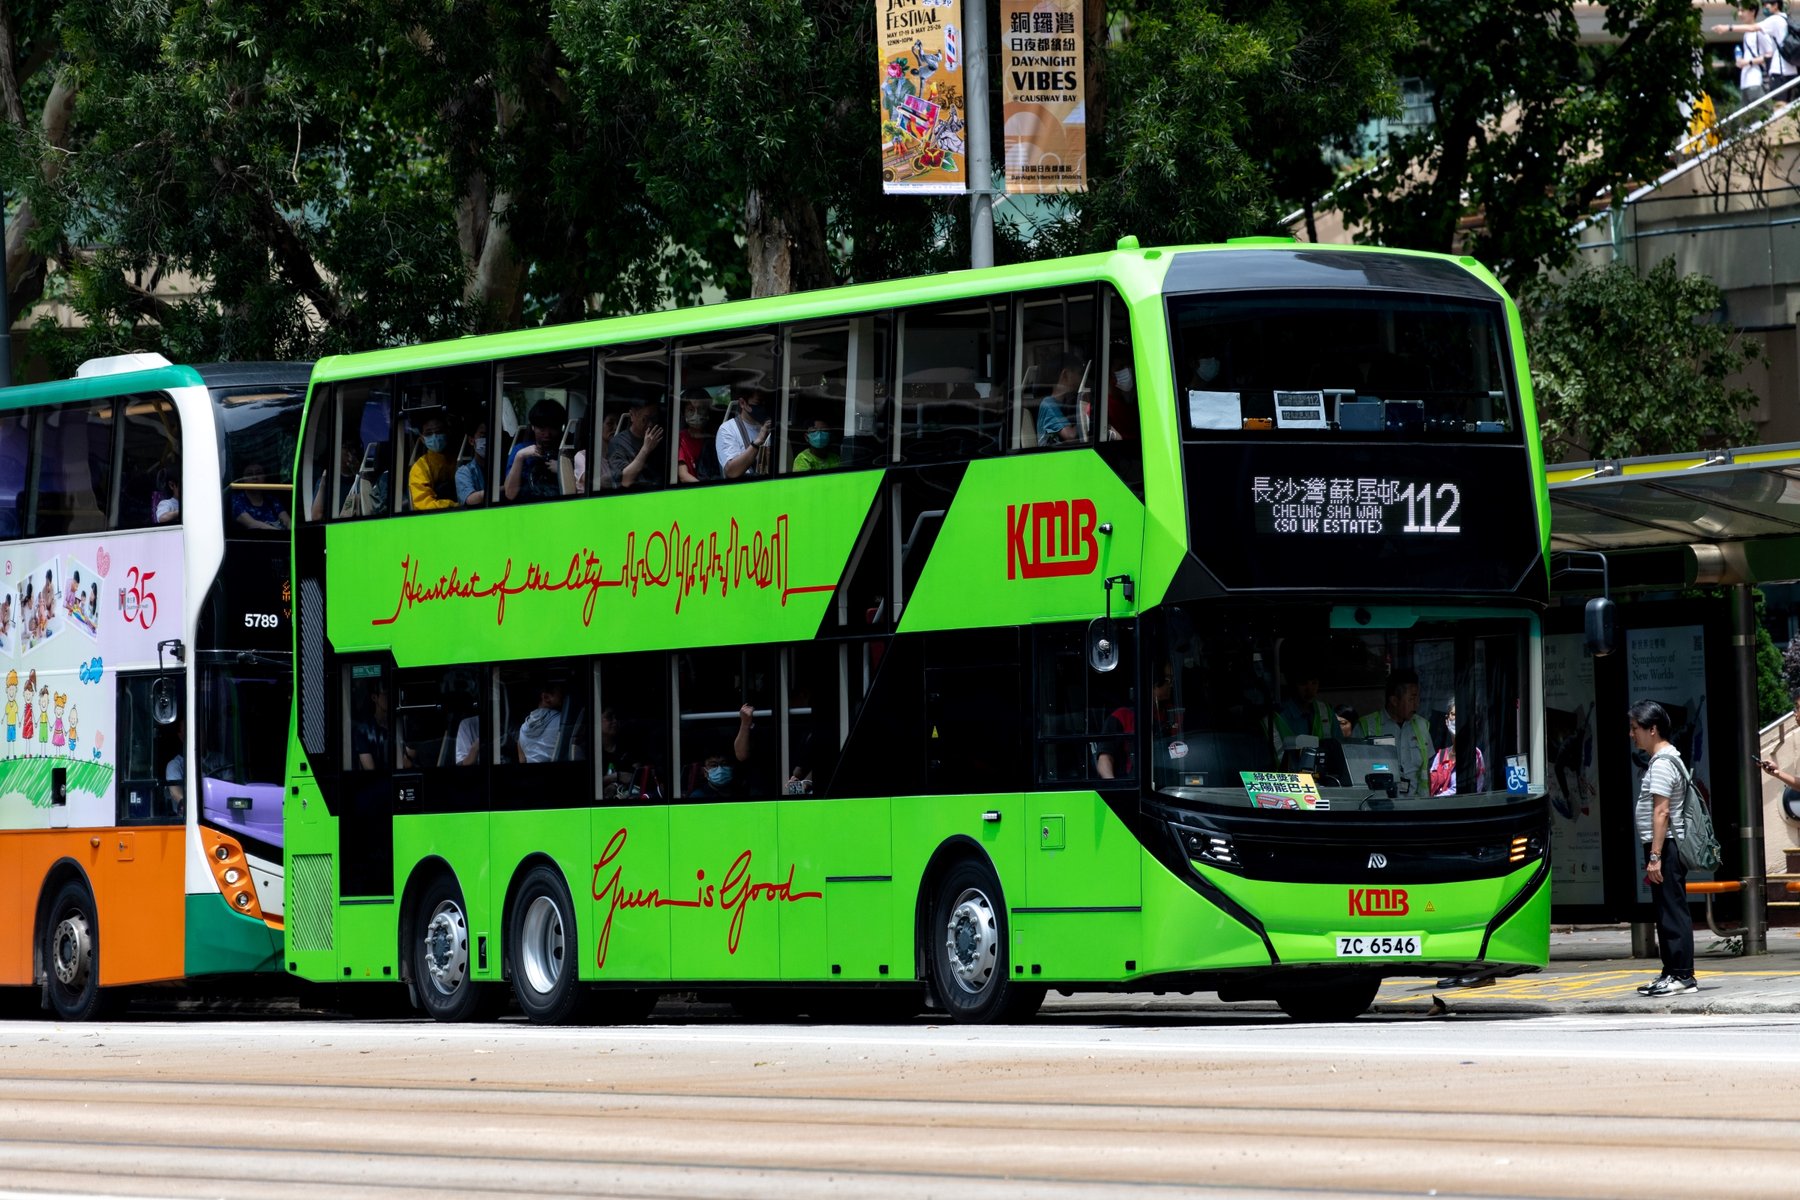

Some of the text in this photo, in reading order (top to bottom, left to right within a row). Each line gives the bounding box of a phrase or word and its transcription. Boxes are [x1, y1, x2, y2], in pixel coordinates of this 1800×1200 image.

[886, 8, 941, 30] FESTIVAL
[1011, 12, 1074, 33] 銅鑼灣
[1011, 38, 1075, 51] 日夜都繽紛
[1012, 71, 1077, 90] VIBES
[1252, 477, 1400, 505] 長沙灣蘇屋邨
[1273, 504, 1382, 519] CHEUNG SHA WAN
[1400, 483, 1461, 533] 112
[1274, 519, 1383, 534] (SO UK ESTATE)
[397, 547, 603, 627] Heartbeat of the City
[123, 566, 157, 630] 35
[244, 613, 278, 628] 5789
[1632, 651, 1667, 668] Symphony
[1669, 650, 1677, 662] of
[1632, 669, 1648, 681] New
[1649, 667, 1674, 680] Worlds
[1246, 782, 1316, 794] 太陽能巴士
[592, 828, 660, 969] Green
[719, 849, 812, 955] Good
[1348, 889, 1410, 917] KMB
[1341, 938, 1416, 955] ZC 6546
